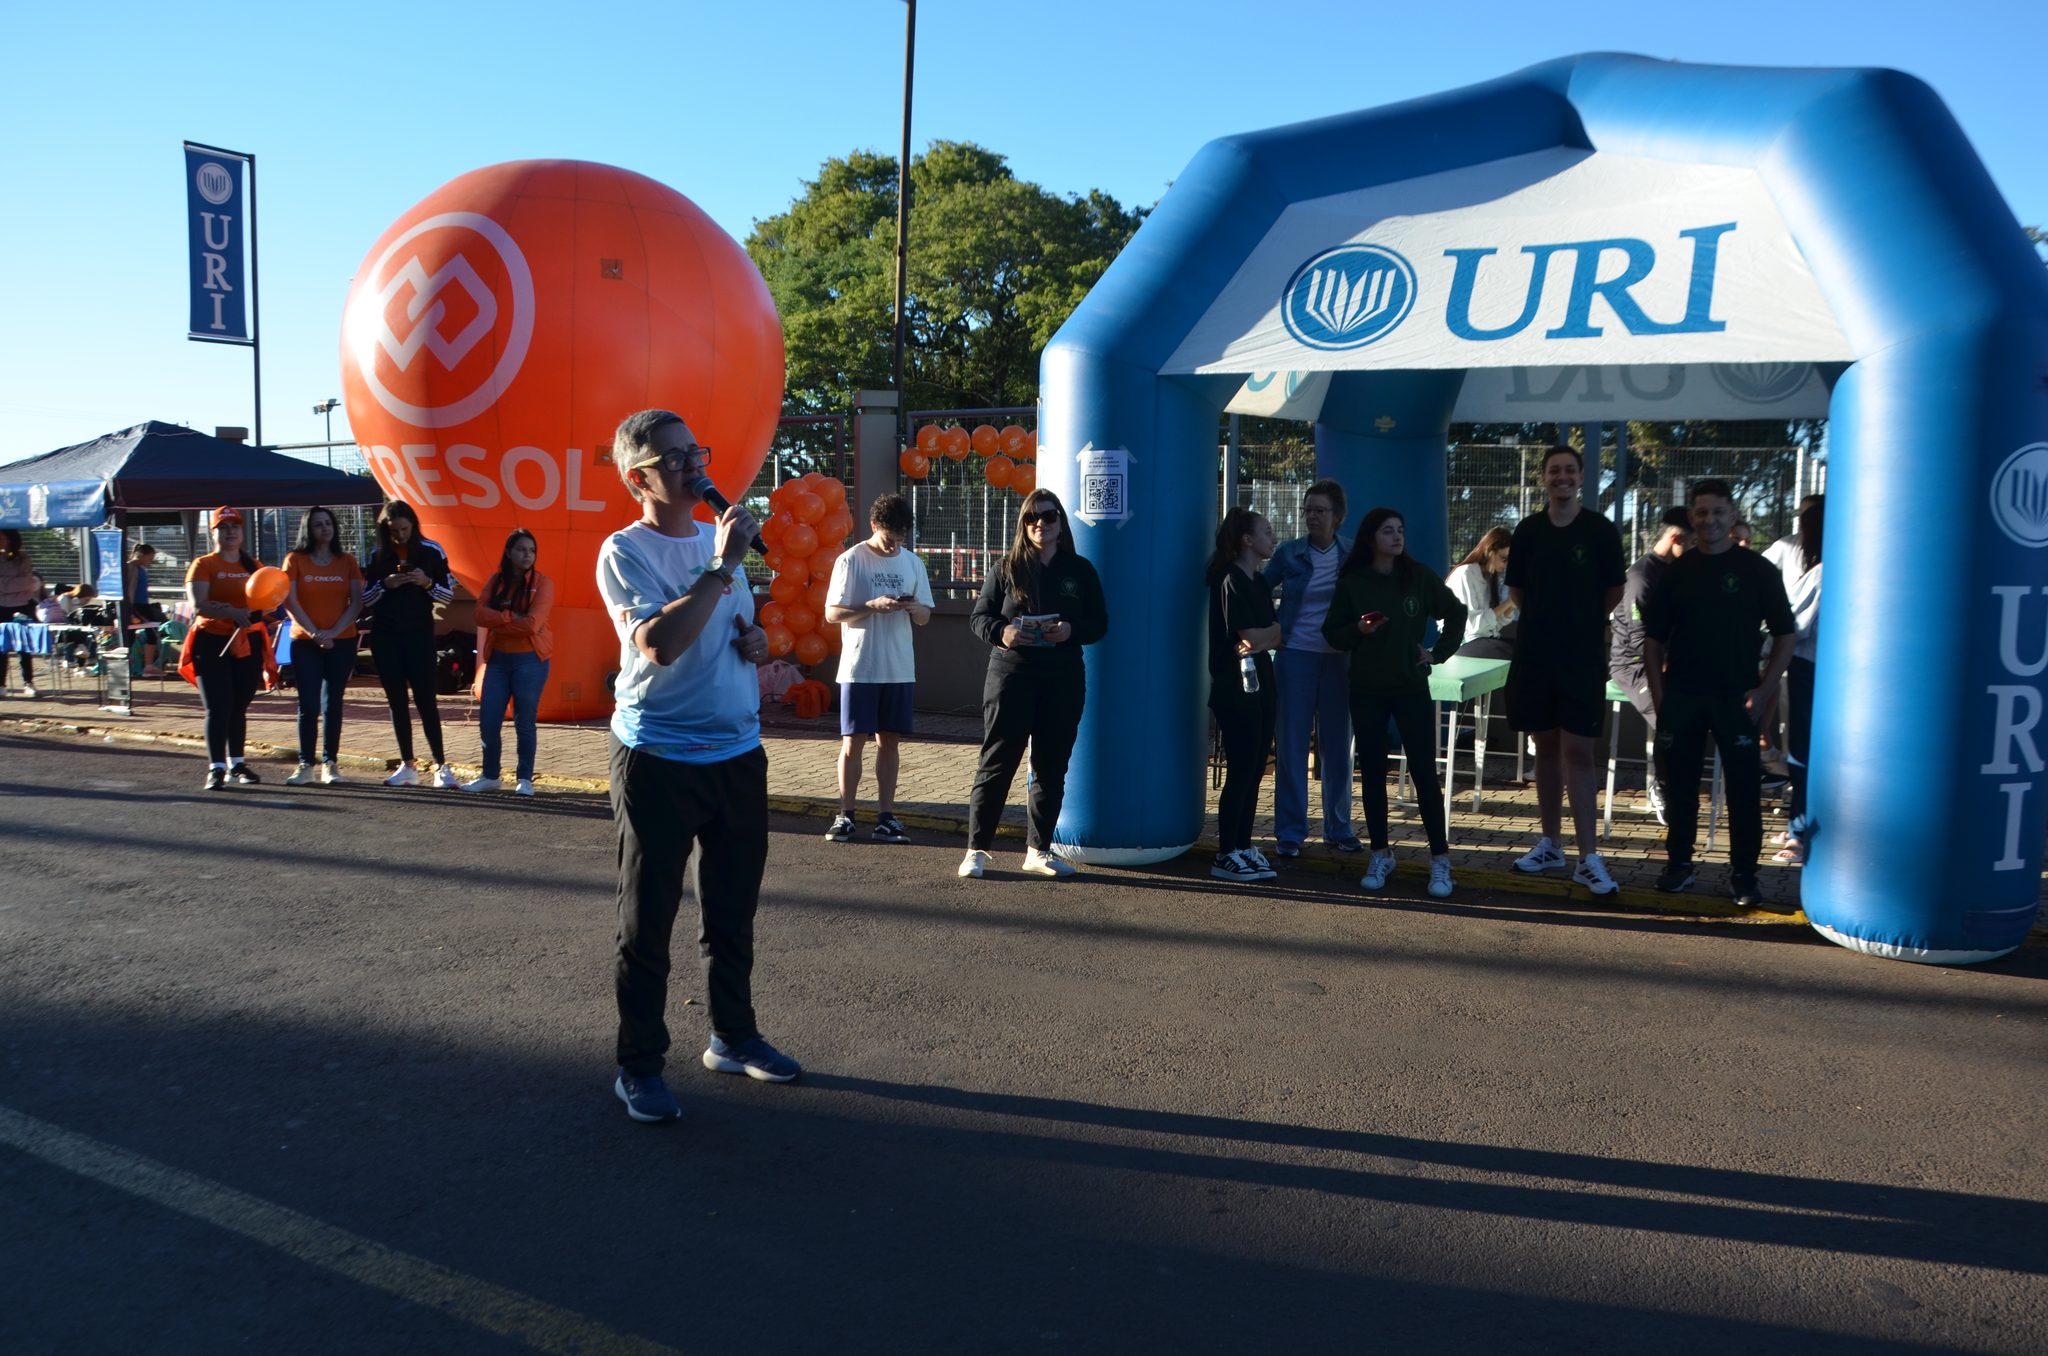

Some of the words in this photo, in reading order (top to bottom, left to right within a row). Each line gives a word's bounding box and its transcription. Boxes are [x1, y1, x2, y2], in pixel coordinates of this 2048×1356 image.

[200, 211, 233, 331] URI
[1442, 220, 1738, 342] URI
[1980, 585, 2048, 872] URI
